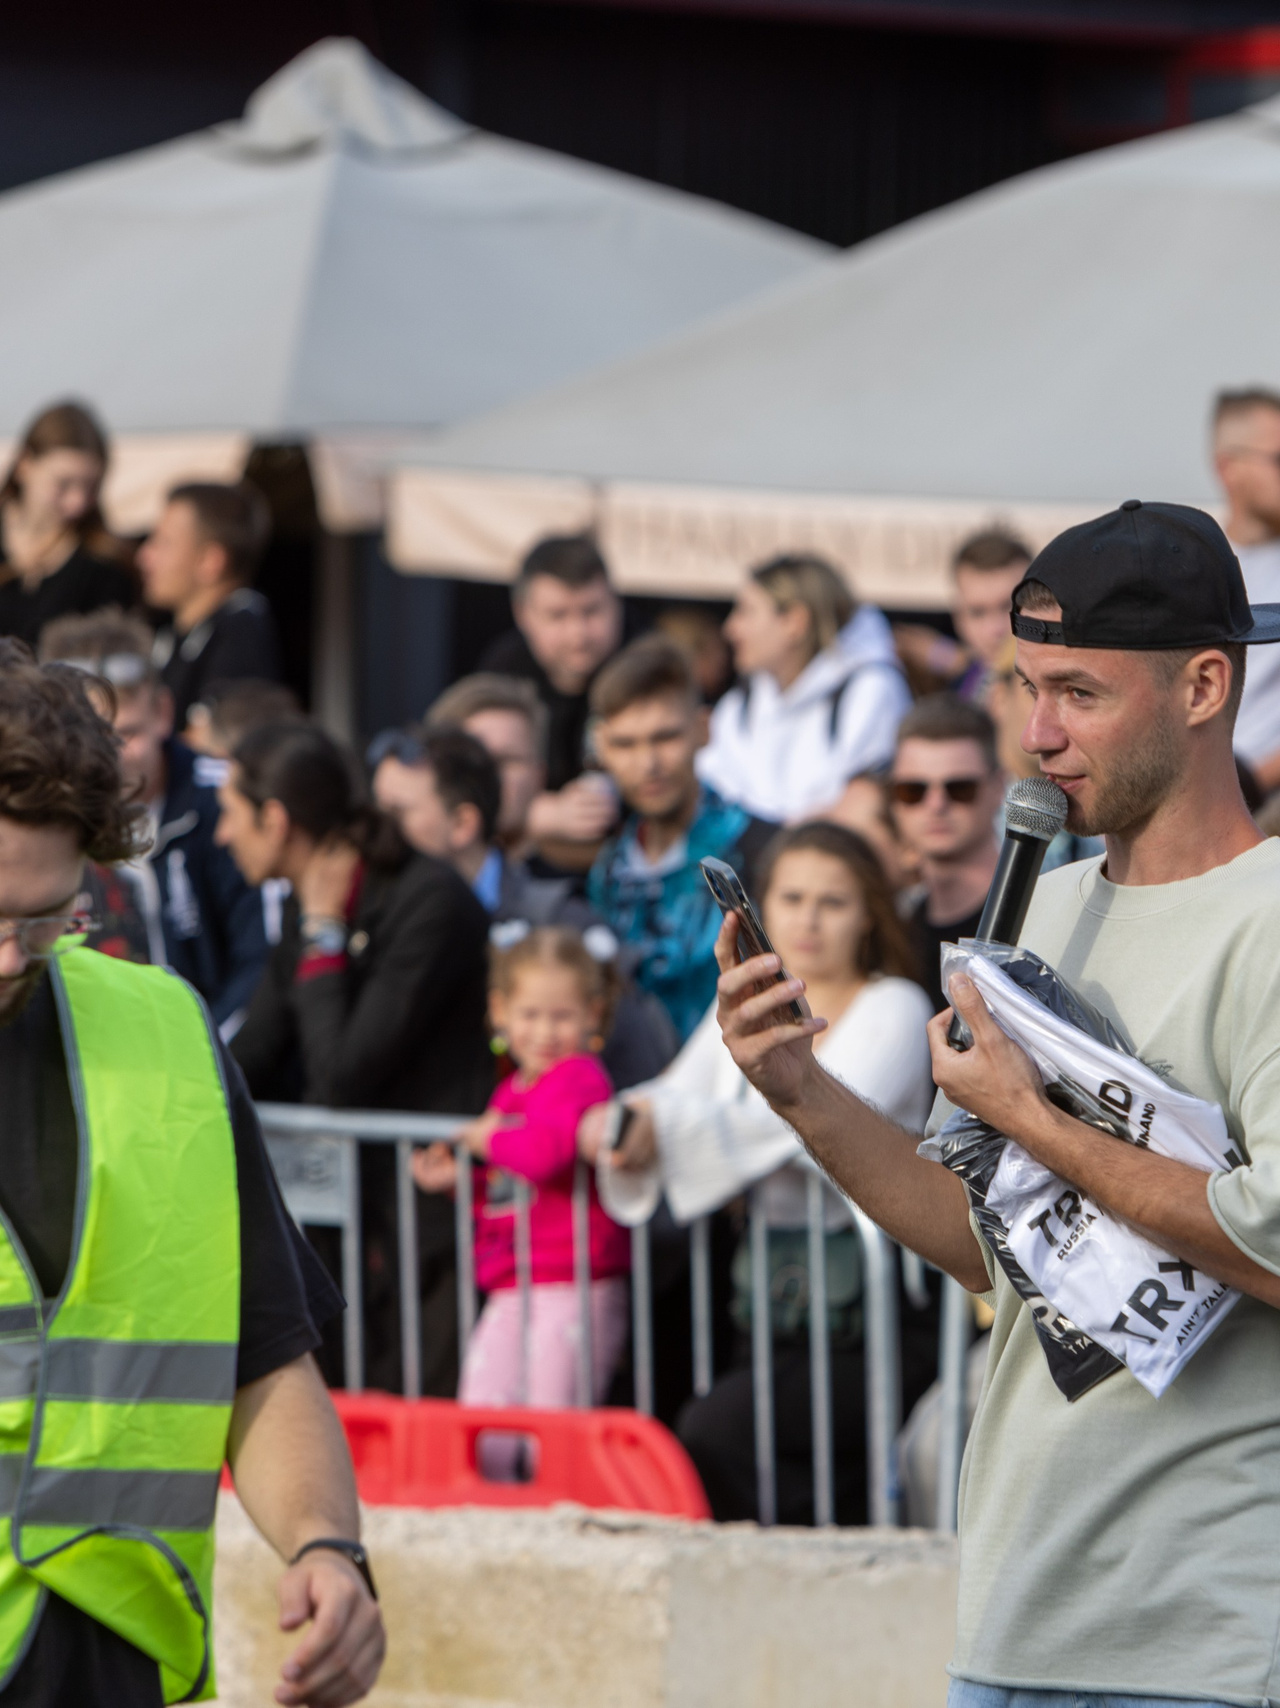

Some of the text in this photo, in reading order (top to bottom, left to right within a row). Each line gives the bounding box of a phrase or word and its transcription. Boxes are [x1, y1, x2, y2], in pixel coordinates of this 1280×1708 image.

[1057, 1213, 1097, 1261] RUSSIA
[1109, 1257, 1200, 1346] TRX
[1176, 1307, 1200, 1346] AIN'T
